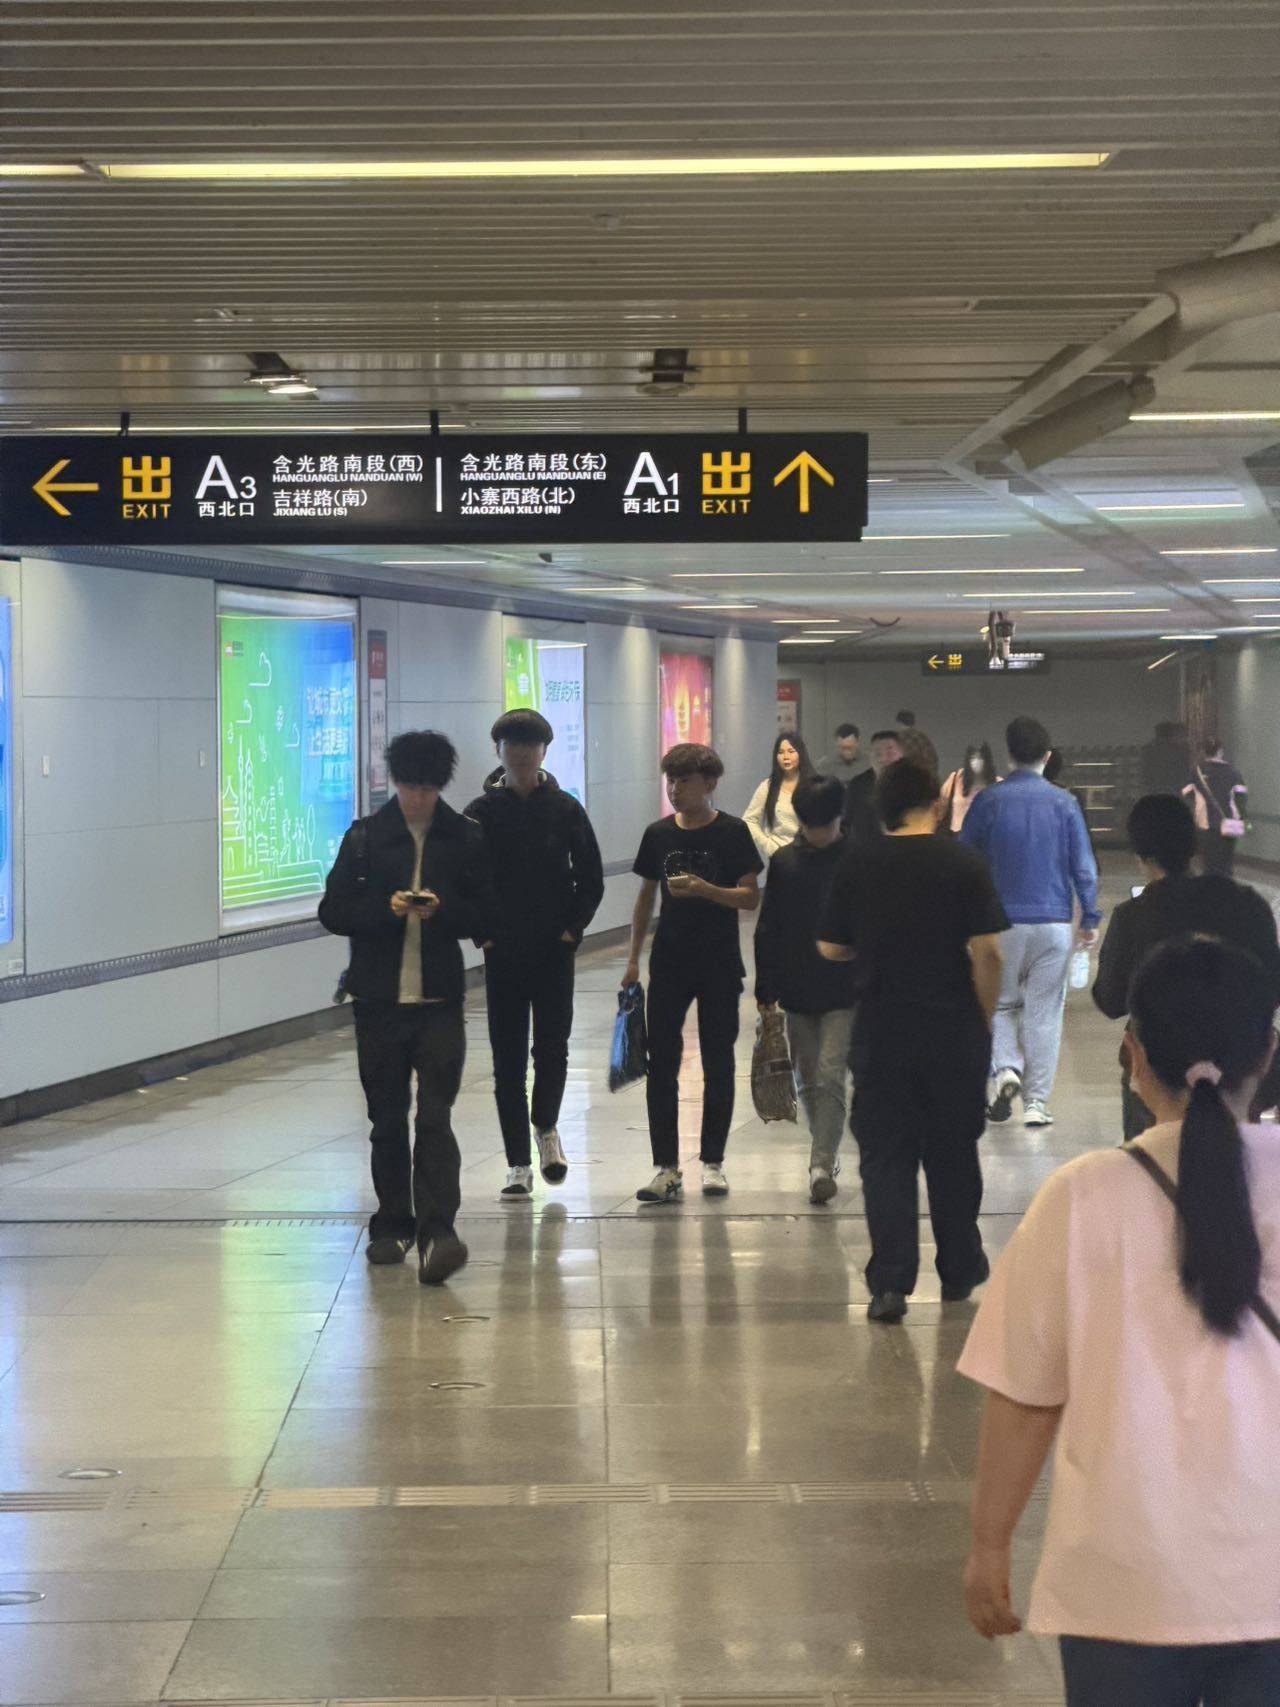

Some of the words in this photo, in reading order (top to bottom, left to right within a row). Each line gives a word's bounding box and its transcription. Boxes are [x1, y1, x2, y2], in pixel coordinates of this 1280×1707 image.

[272, 454, 424, 473] 含光路南段(西)
[460, 453, 607, 471] 含光路南段(东)
[123, 456, 171, 500] 出
[195, 455, 257, 500] A3
[272, 473, 348, 483] HANGUANGLU
[350, 473, 404, 483] NANDUAN
[405, 473, 423, 483] (W)
[460, 472, 535, 481] HANGUANGLU
[537, 472, 591, 481] NANDUAN
[593, 472, 606, 481] (E)
[624, 452, 679, 495] A1
[702, 452, 751, 496] 出
[273, 488, 368, 507] 吉祥路(南)
[460, 486, 576, 505] 小寨西路(北)
[123, 503, 171, 518] EXIT
[198, 500, 255, 518] 西北口
[273, 507, 316, 517] JIXIANG
[317, 507, 332, 517] LU
[333, 507, 347, 517] (S)
[460, 505, 515, 515] XIAOZHAI
[516, 505, 542, 515] XILU
[544, 505, 561, 515] (N)
[623, 497, 680, 515] 西北口
[702, 499, 751, 514] EXIT
